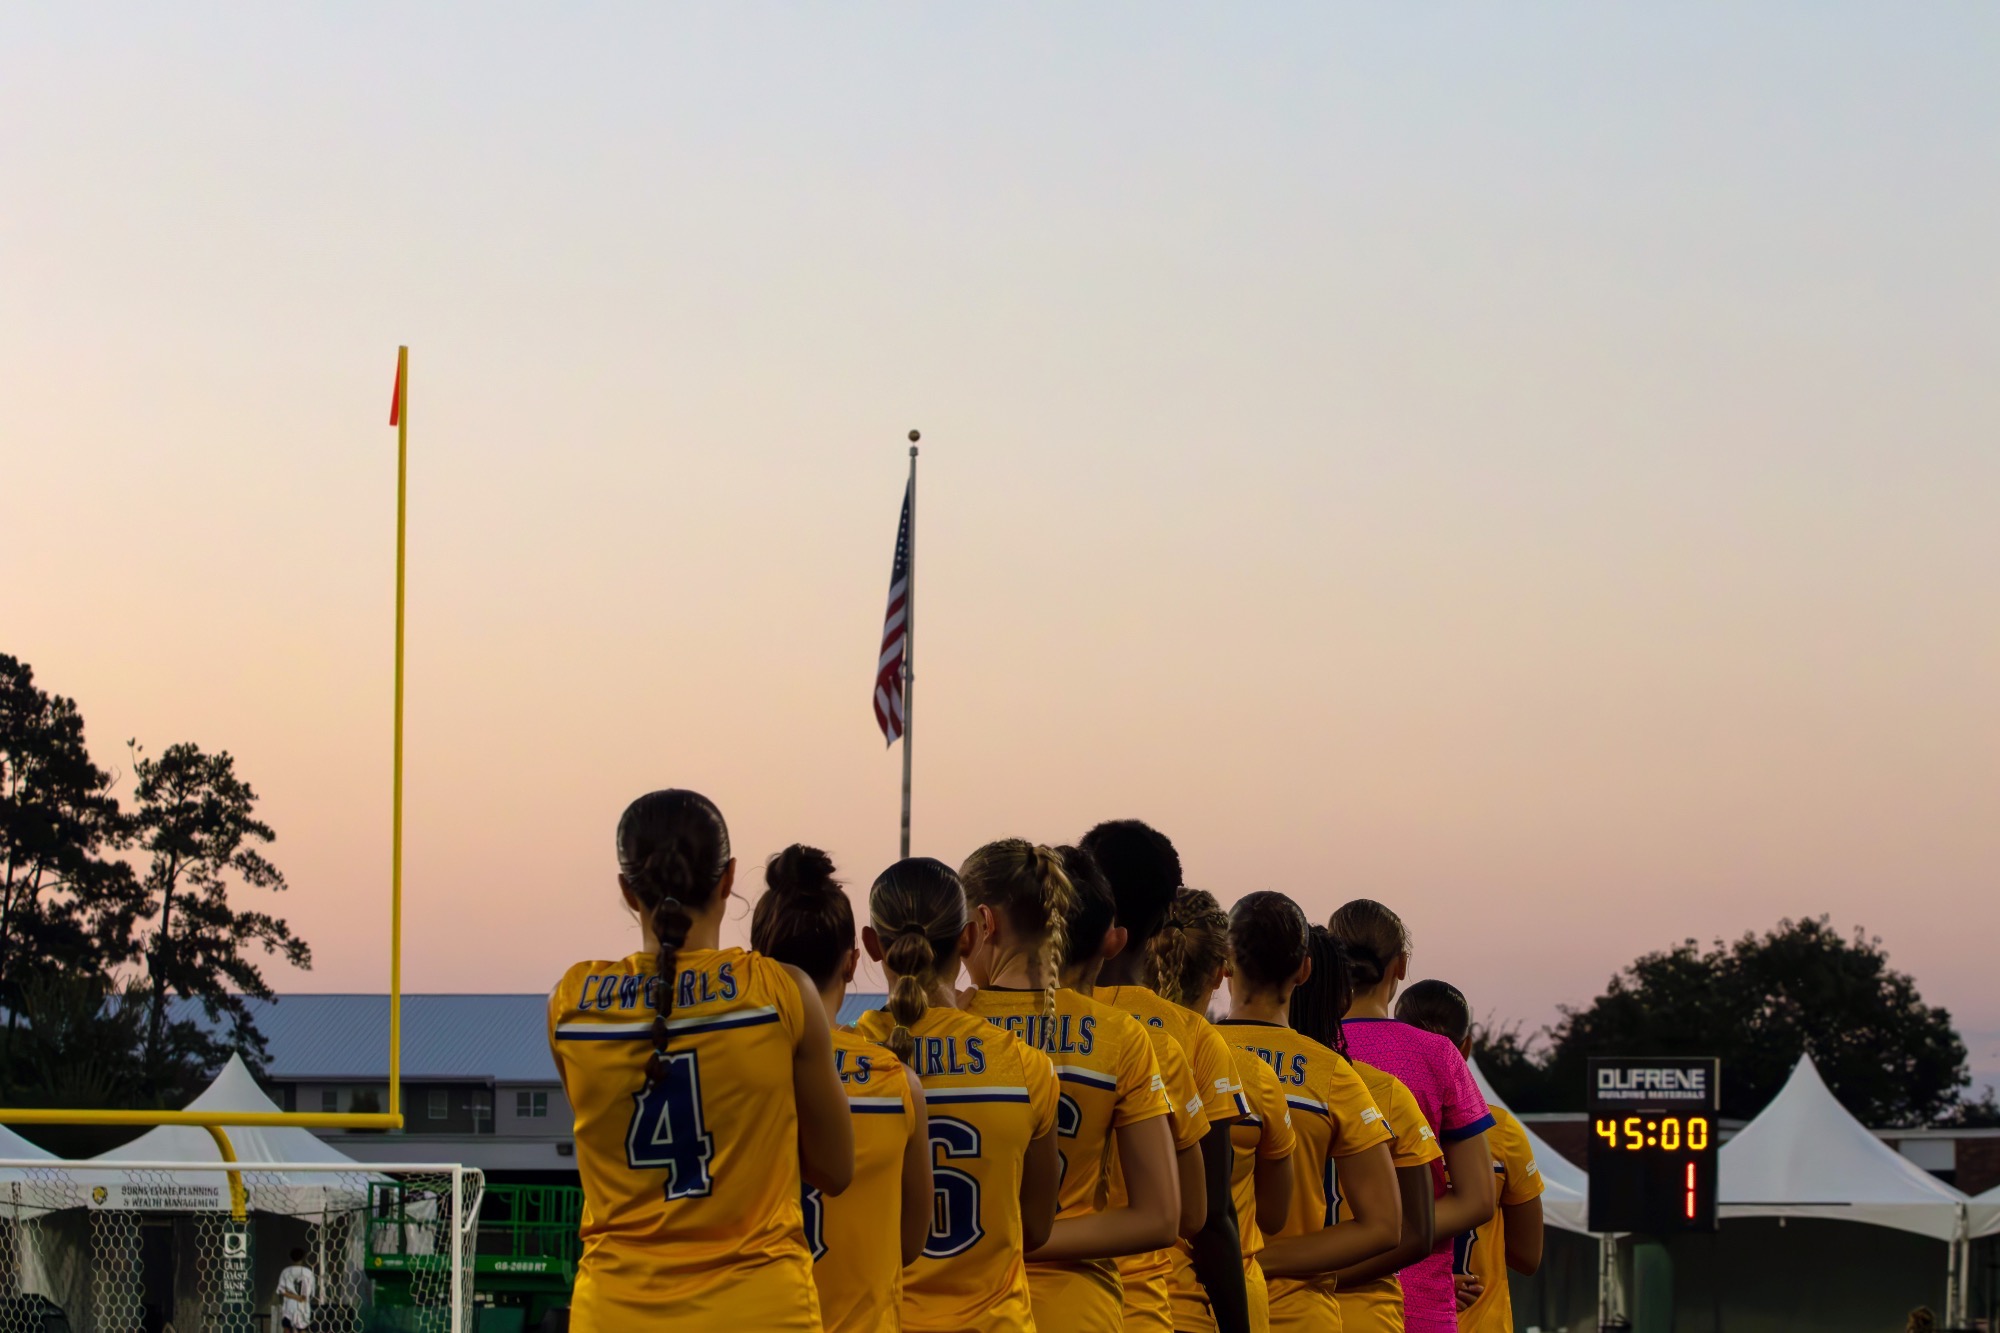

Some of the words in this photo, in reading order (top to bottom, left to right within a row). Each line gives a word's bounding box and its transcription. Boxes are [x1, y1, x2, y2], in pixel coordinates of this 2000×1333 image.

[577, 962, 738, 1011] COWGRLS
[908, 1036, 987, 1076] IRLS
[1598, 1068, 1705, 1089] DUFRENE
[1598, 1090, 1646, 1099] BUILDING
[1647, 1090, 1705, 1099] MATERIALS
[625, 1049, 714, 1201] 4
[1596, 1117, 1708, 1150] 45:00
[132, 1198, 161, 1207] WEALTH
[164, 1198, 219, 1207] MANAGEMENT
[150, 1185, 175, 1196] ESTATE
[178, 1185, 219, 1196] PLANNING
[921, 1115, 985, 1259] 6
[1686, 1162, 1695, 1219] 1
